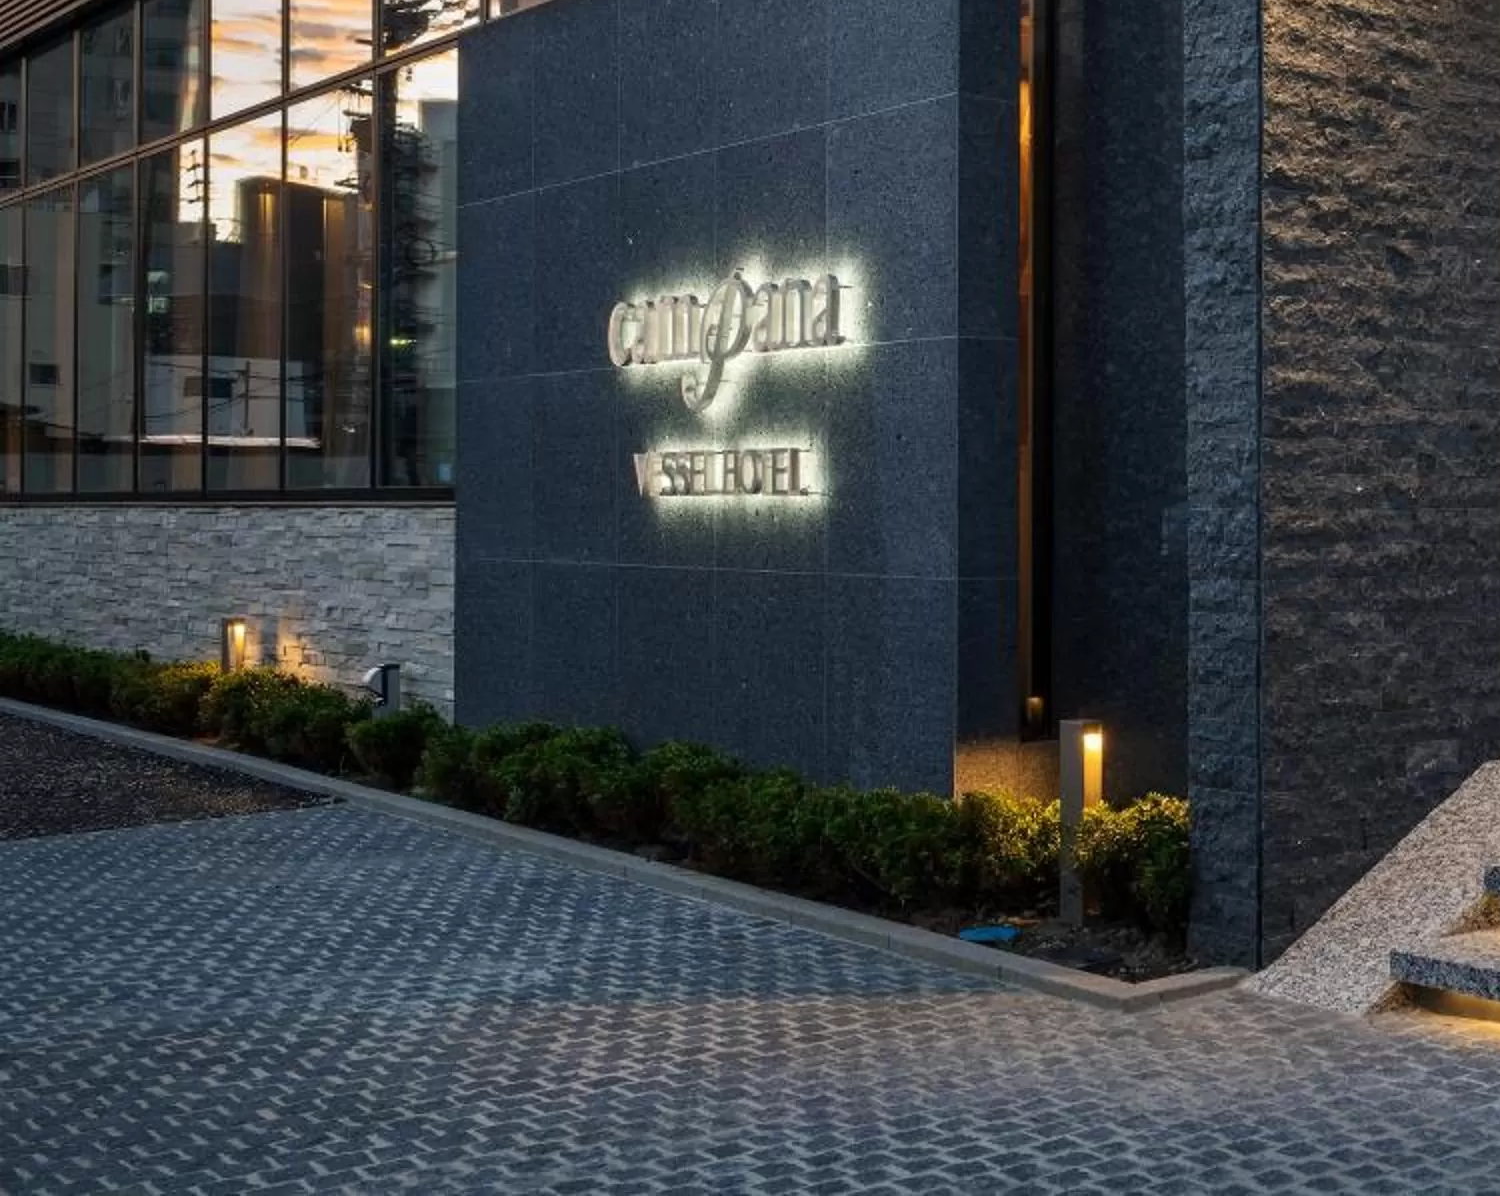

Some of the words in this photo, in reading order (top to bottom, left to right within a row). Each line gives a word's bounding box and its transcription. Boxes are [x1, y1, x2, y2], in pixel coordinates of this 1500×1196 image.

[607, 269, 847, 412] campana
[633, 449, 722, 497] VESSEL
[723, 447, 809, 497] HOTEL
